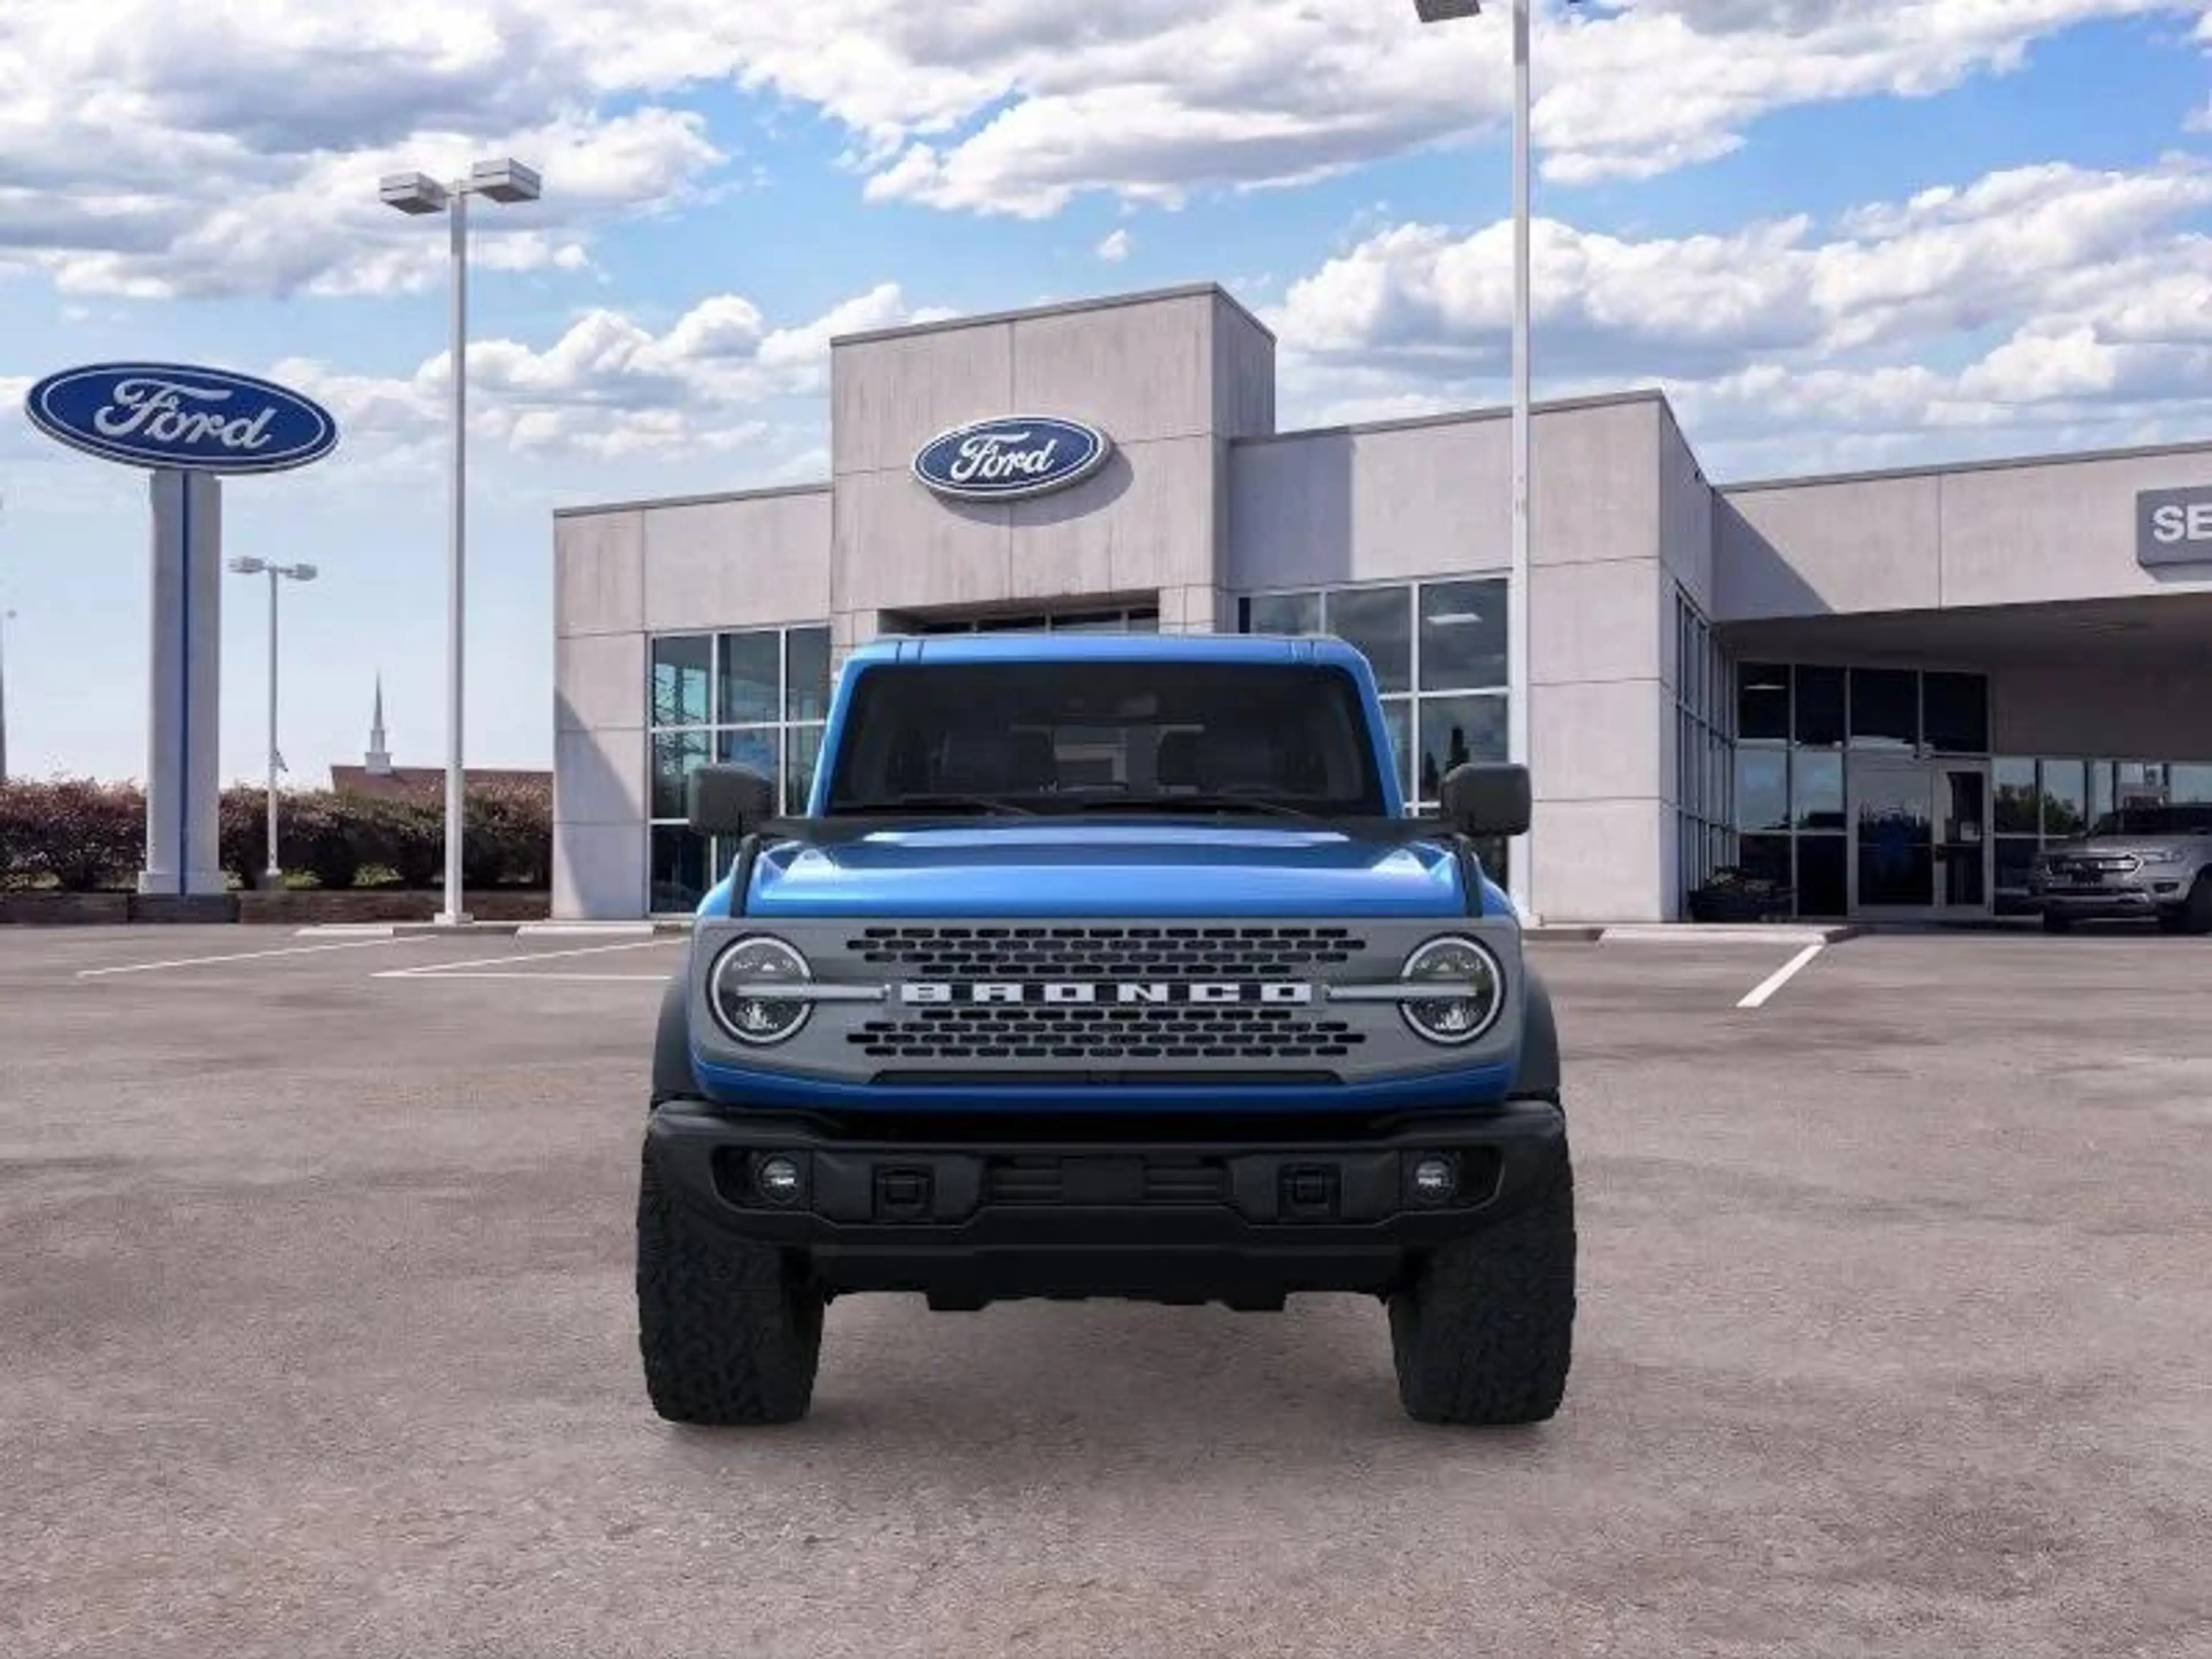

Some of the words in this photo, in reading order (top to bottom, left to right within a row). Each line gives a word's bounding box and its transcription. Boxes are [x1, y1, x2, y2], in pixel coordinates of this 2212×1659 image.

[94, 378, 276, 449] Ford
[950, 431, 1058, 482] Ford
[2153, 503, 2212, 542] SE
[901, 983, 1312, 1003] BRONCO
